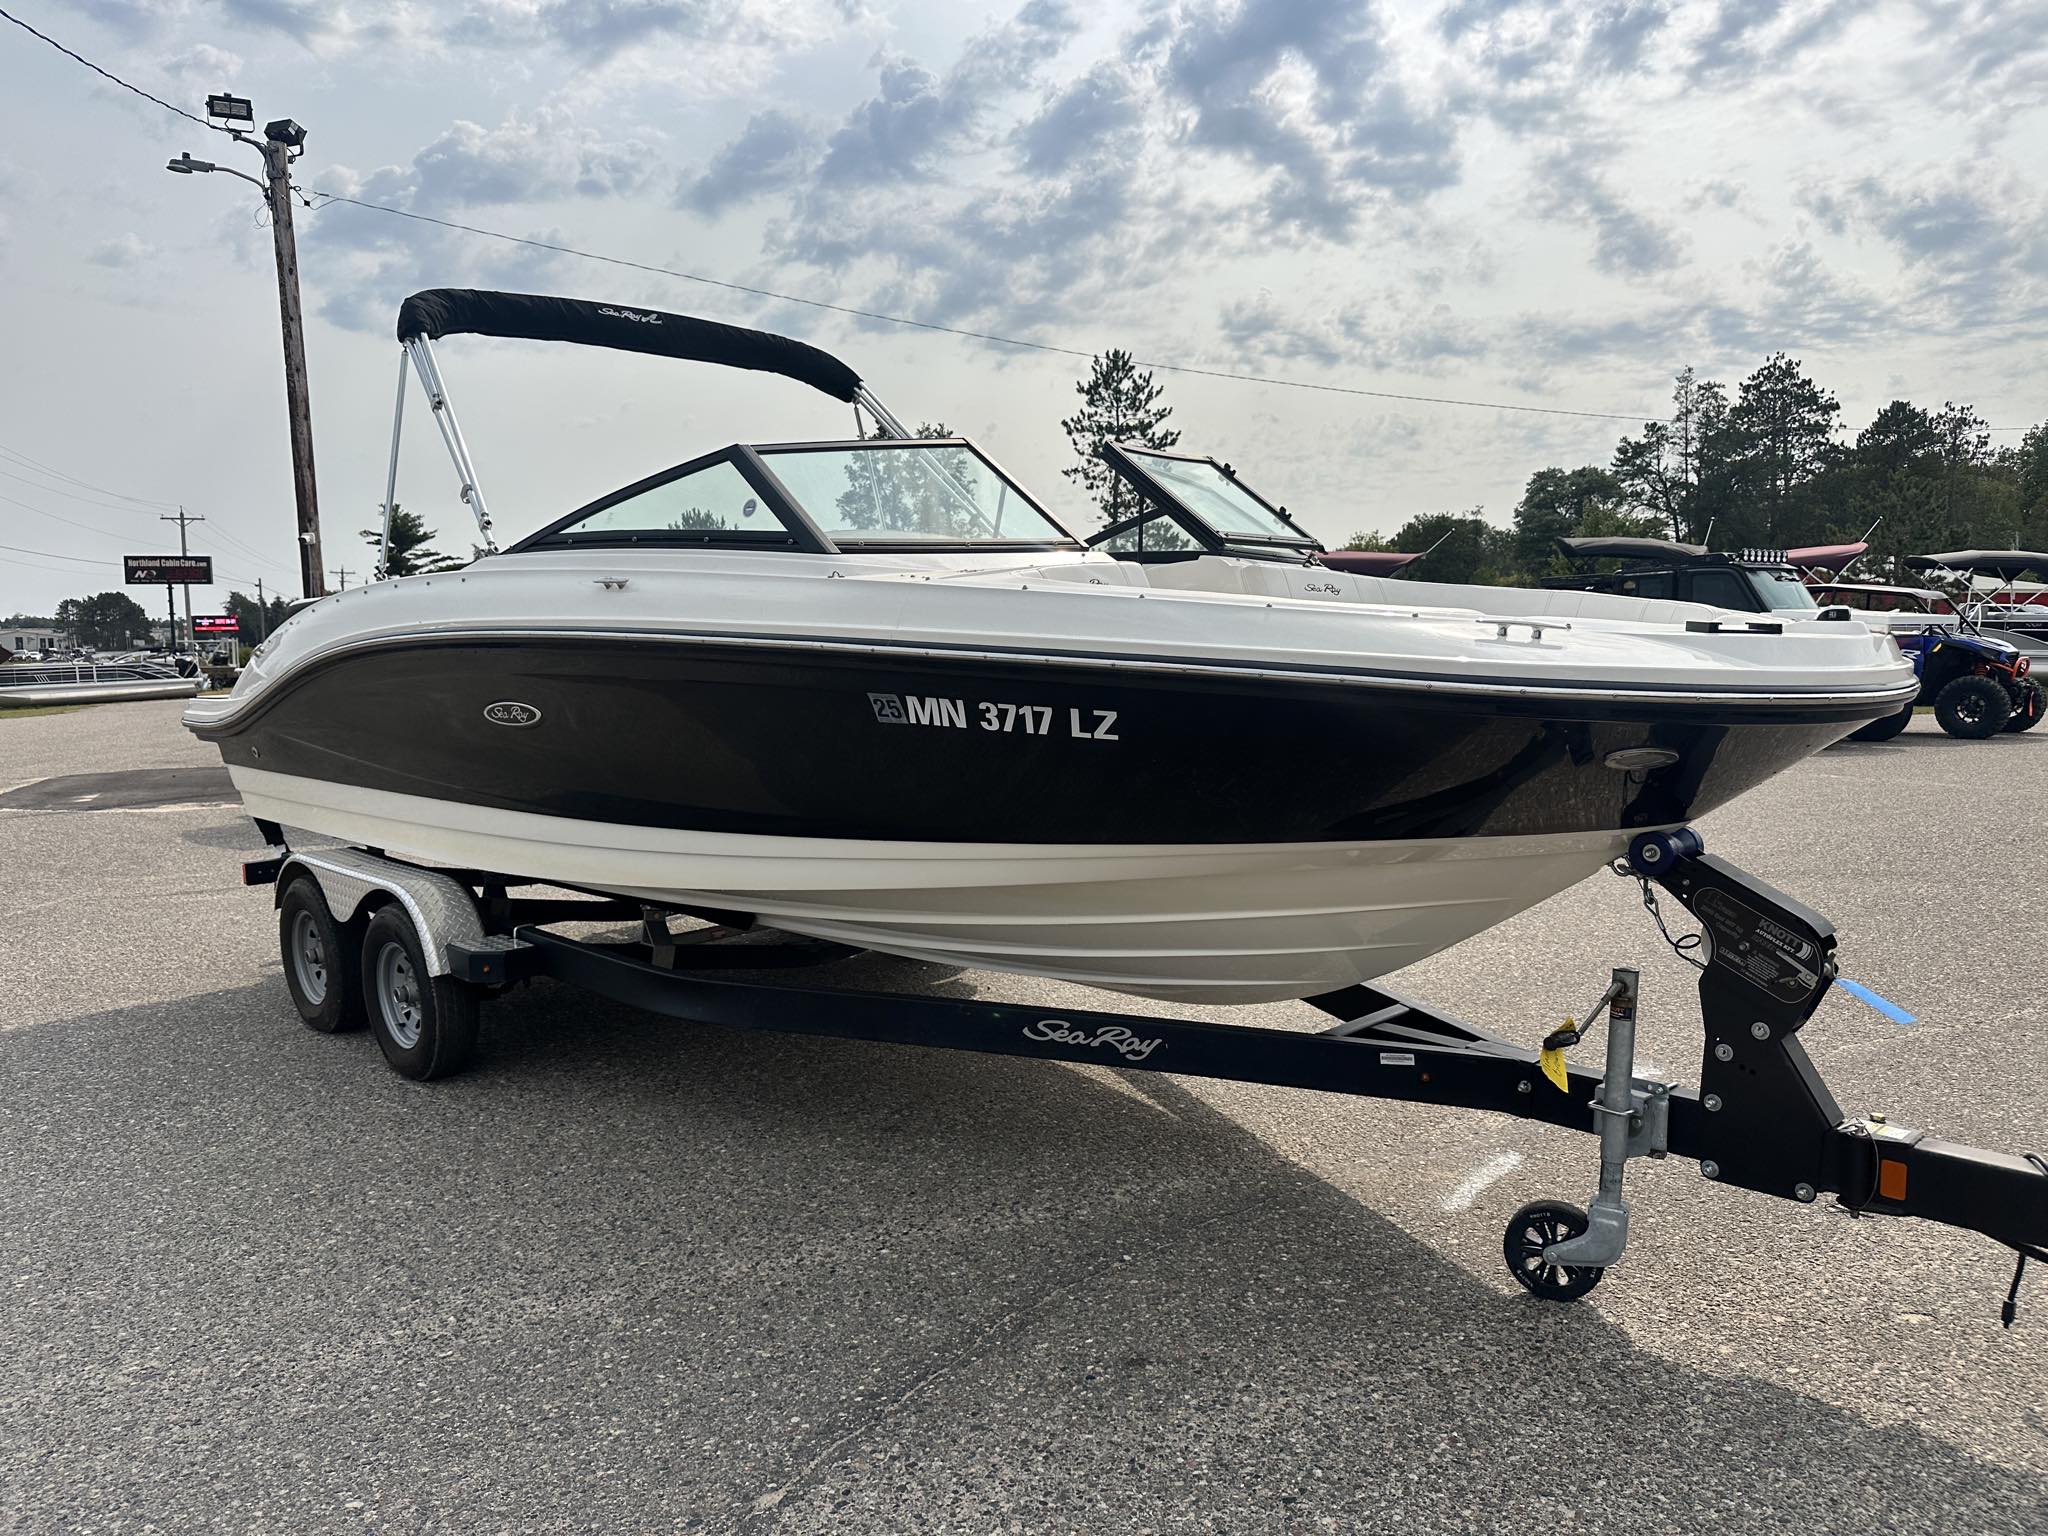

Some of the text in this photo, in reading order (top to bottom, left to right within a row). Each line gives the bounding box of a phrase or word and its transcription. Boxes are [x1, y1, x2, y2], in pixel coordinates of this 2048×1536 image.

[598, 307, 641, 322] Sea Ray
[127, 559, 160, 567] Northland
[161, 559, 180, 567] Cabin
[1303, 583, 1342, 596] Sea Ray
[491, 706, 529, 723] Sea Ray
[872, 695, 1119, 741] 25 MN 3717 LZ
[1758, 918, 1801, 948] KNOTT
[1022, 1019, 1163, 1061] Sea Ray
